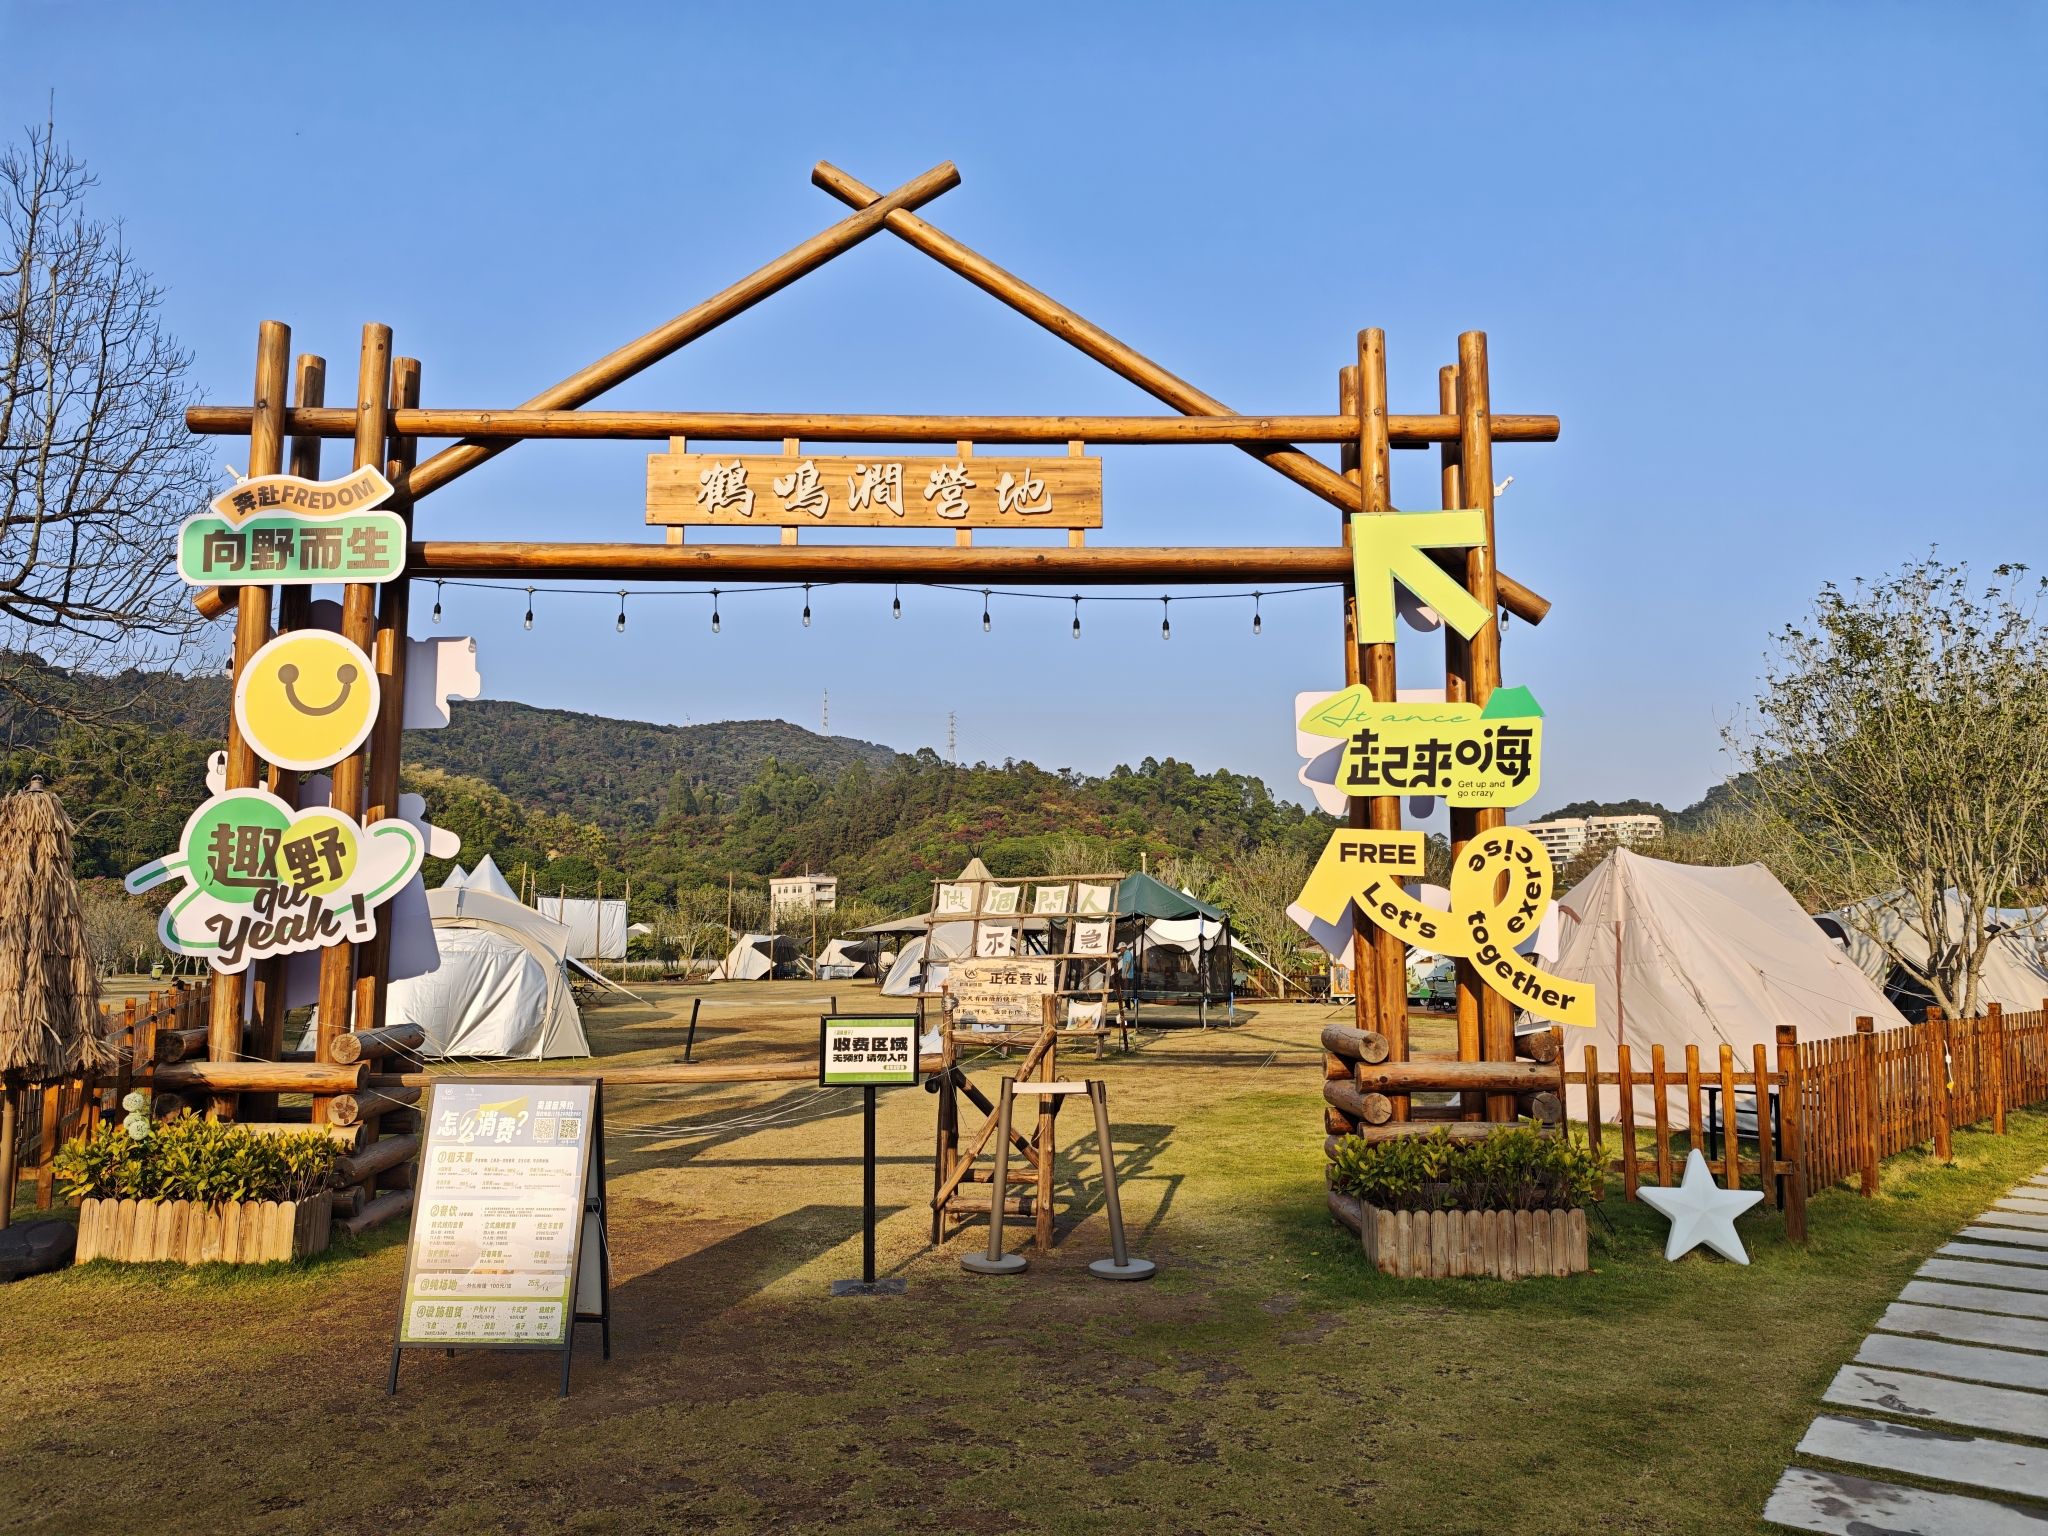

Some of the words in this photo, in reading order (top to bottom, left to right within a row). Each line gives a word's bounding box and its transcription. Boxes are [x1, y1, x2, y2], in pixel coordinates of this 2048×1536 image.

[202, 526, 389, 572] 向野而生
[1457, 780, 1476, 789] Get
[1478, 782, 1487, 790] up
[1489, 780, 1505, 788] and
[1457, 790, 1468, 799] go
[1471, 789, 1494, 799] crazy
[207, 823, 347, 890] 趣野
[1339, 842, 1416, 865] FREE
[1469, 839, 1542, 933] exercise
[1362, 881, 1438, 939] Let's
[1080, 929, 1102, 949] 急
[1467, 910, 1576, 1010] together
[989, 972, 1048, 986] 正在营业
[833, 1037, 908, 1052] 收费区域
[833, 1054, 863, 1062] 无预约
[867, 1054, 908, 1062] 请勿入内
